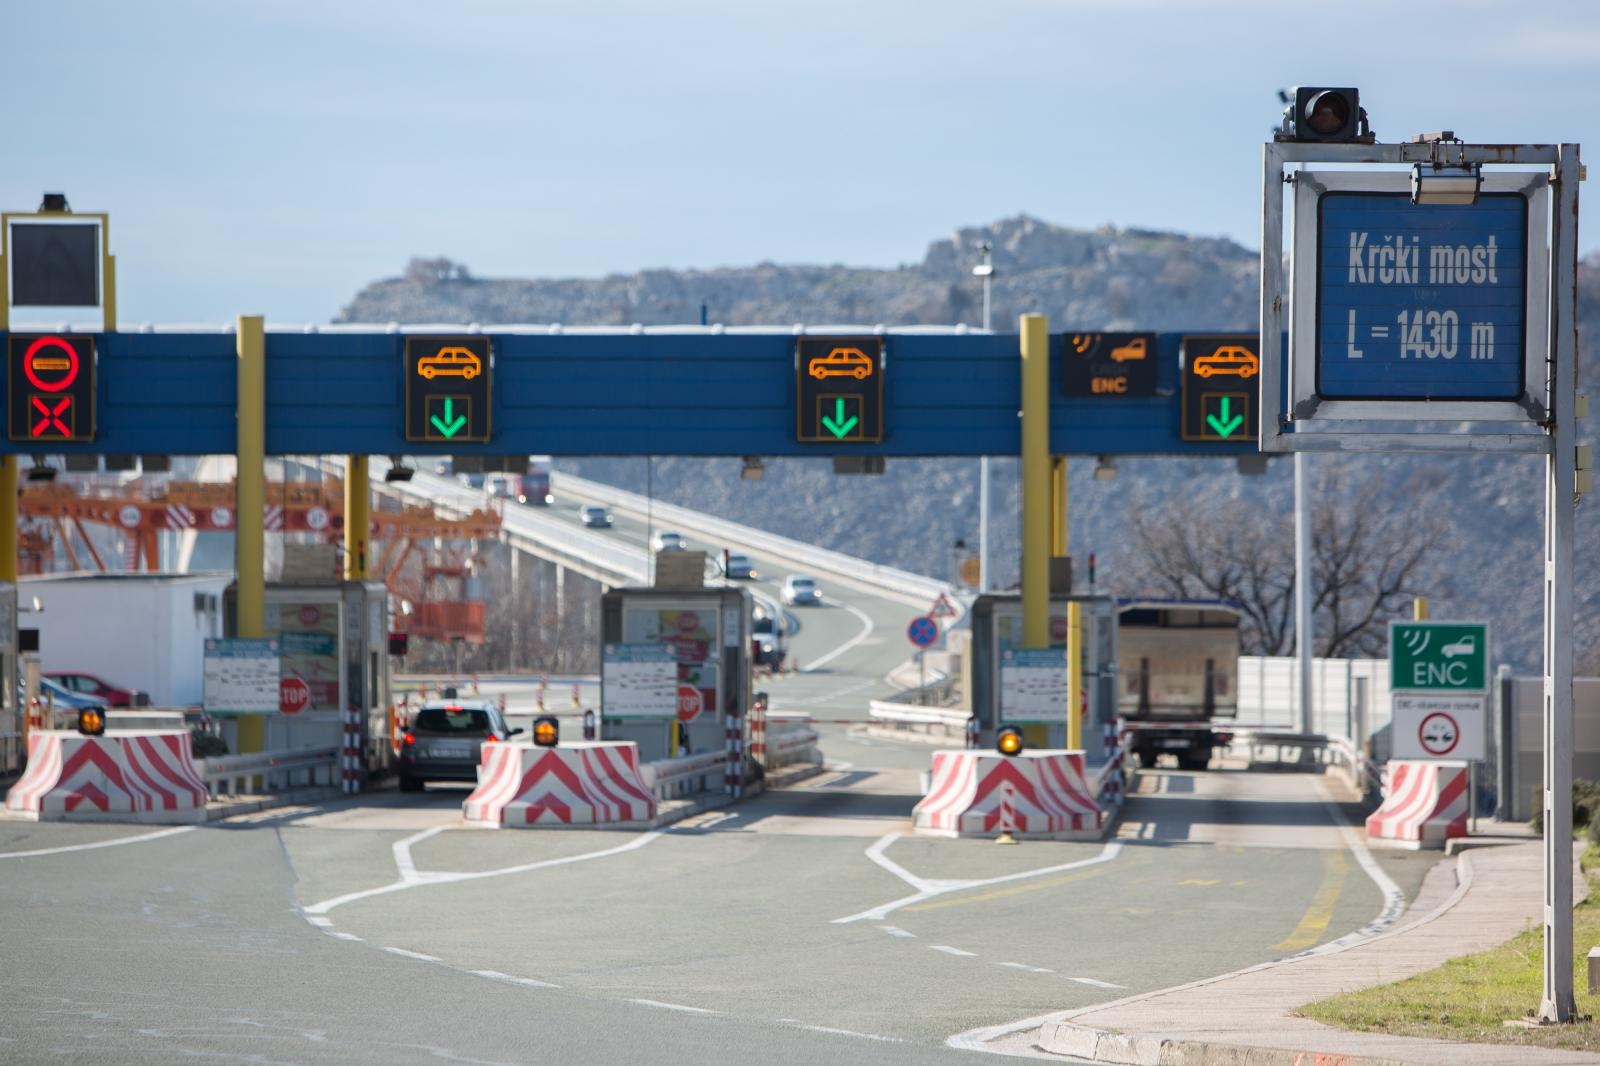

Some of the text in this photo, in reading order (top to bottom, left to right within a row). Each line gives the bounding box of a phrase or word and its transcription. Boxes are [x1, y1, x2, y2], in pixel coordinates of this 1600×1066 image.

[1348, 232, 1498, 284] Krčki most
[1347, 309, 1495, 360] L = 1430 m
[1091, 376, 1127, 394] ENC
[1413, 661, 1468, 686] ENC
[280, 687, 307, 705] TOP
